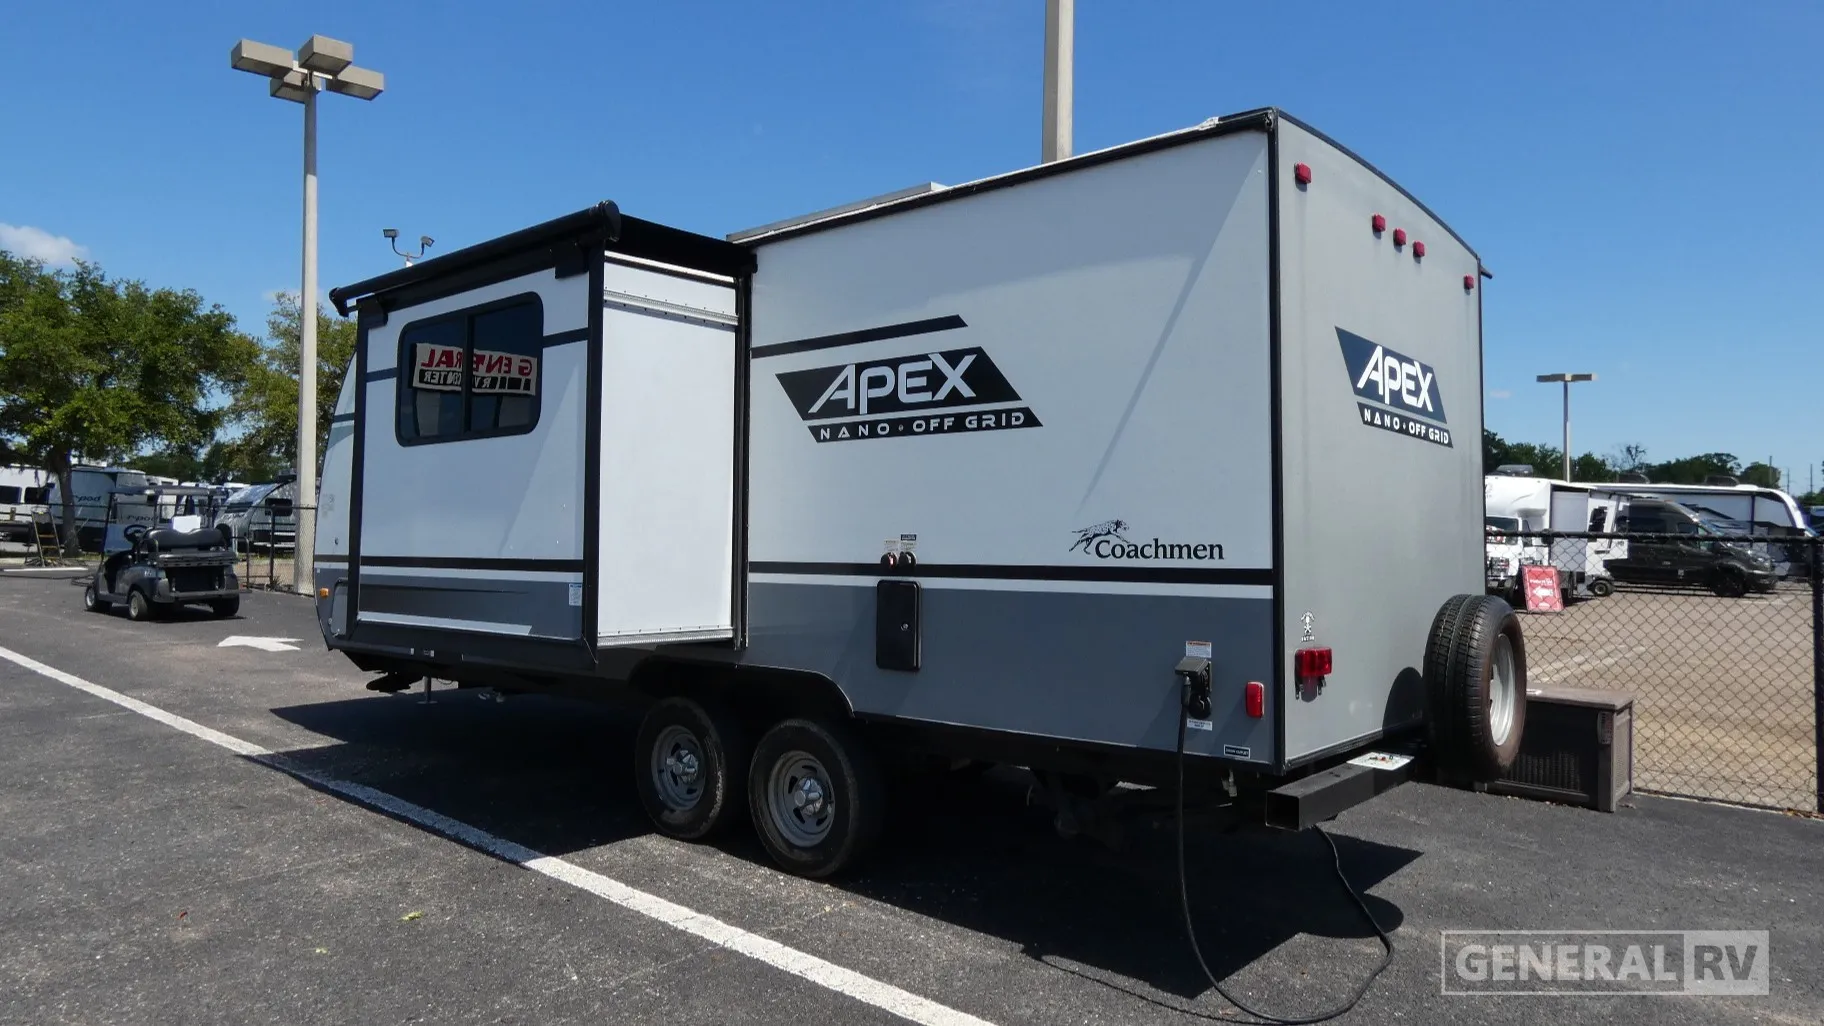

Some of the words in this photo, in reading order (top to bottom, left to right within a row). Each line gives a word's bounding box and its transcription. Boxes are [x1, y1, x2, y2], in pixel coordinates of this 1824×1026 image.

[807, 352, 978, 414] APEX
[1357, 345, 1434, 412] APEX
[820, 422, 890, 440] NANO
[912, 417, 955, 432] OFF
[965, 412, 1025, 429] GRID
[1364, 408, 1400, 430] NANO
[1408, 422, 1426, 437] OFF
[1428, 428, 1449, 444] GRID
[1094, 538, 1225, 560] Coachmen
